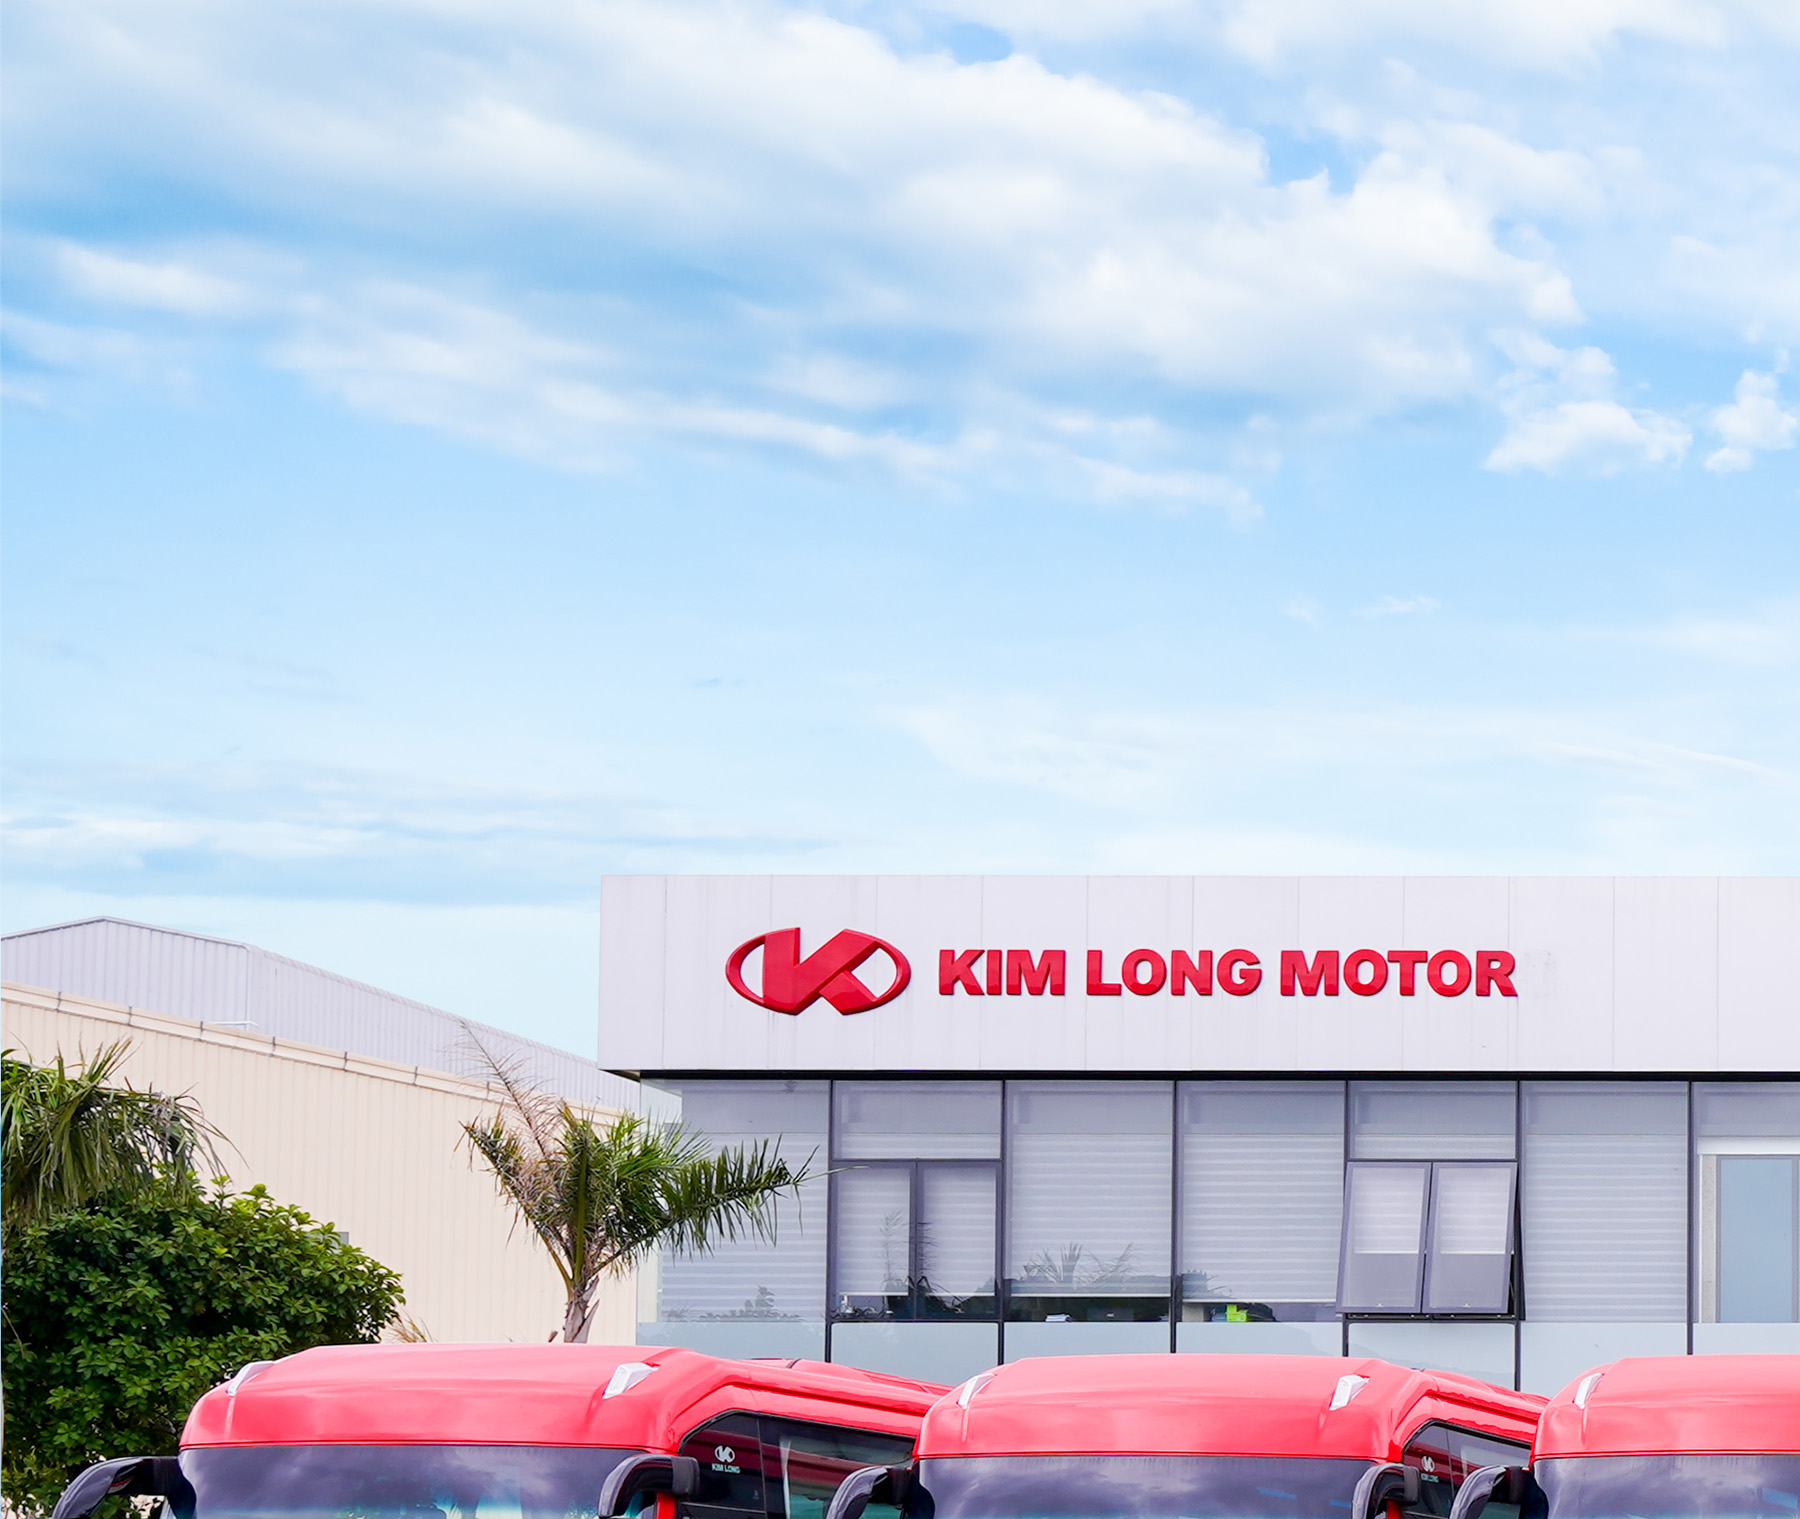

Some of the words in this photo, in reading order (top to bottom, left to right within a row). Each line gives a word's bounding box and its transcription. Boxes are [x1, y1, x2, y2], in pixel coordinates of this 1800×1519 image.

[938, 948, 1066, 996] KIM
[1086, 948, 1263, 997] LONG
[1280, 948, 1519, 997] MOTOR
